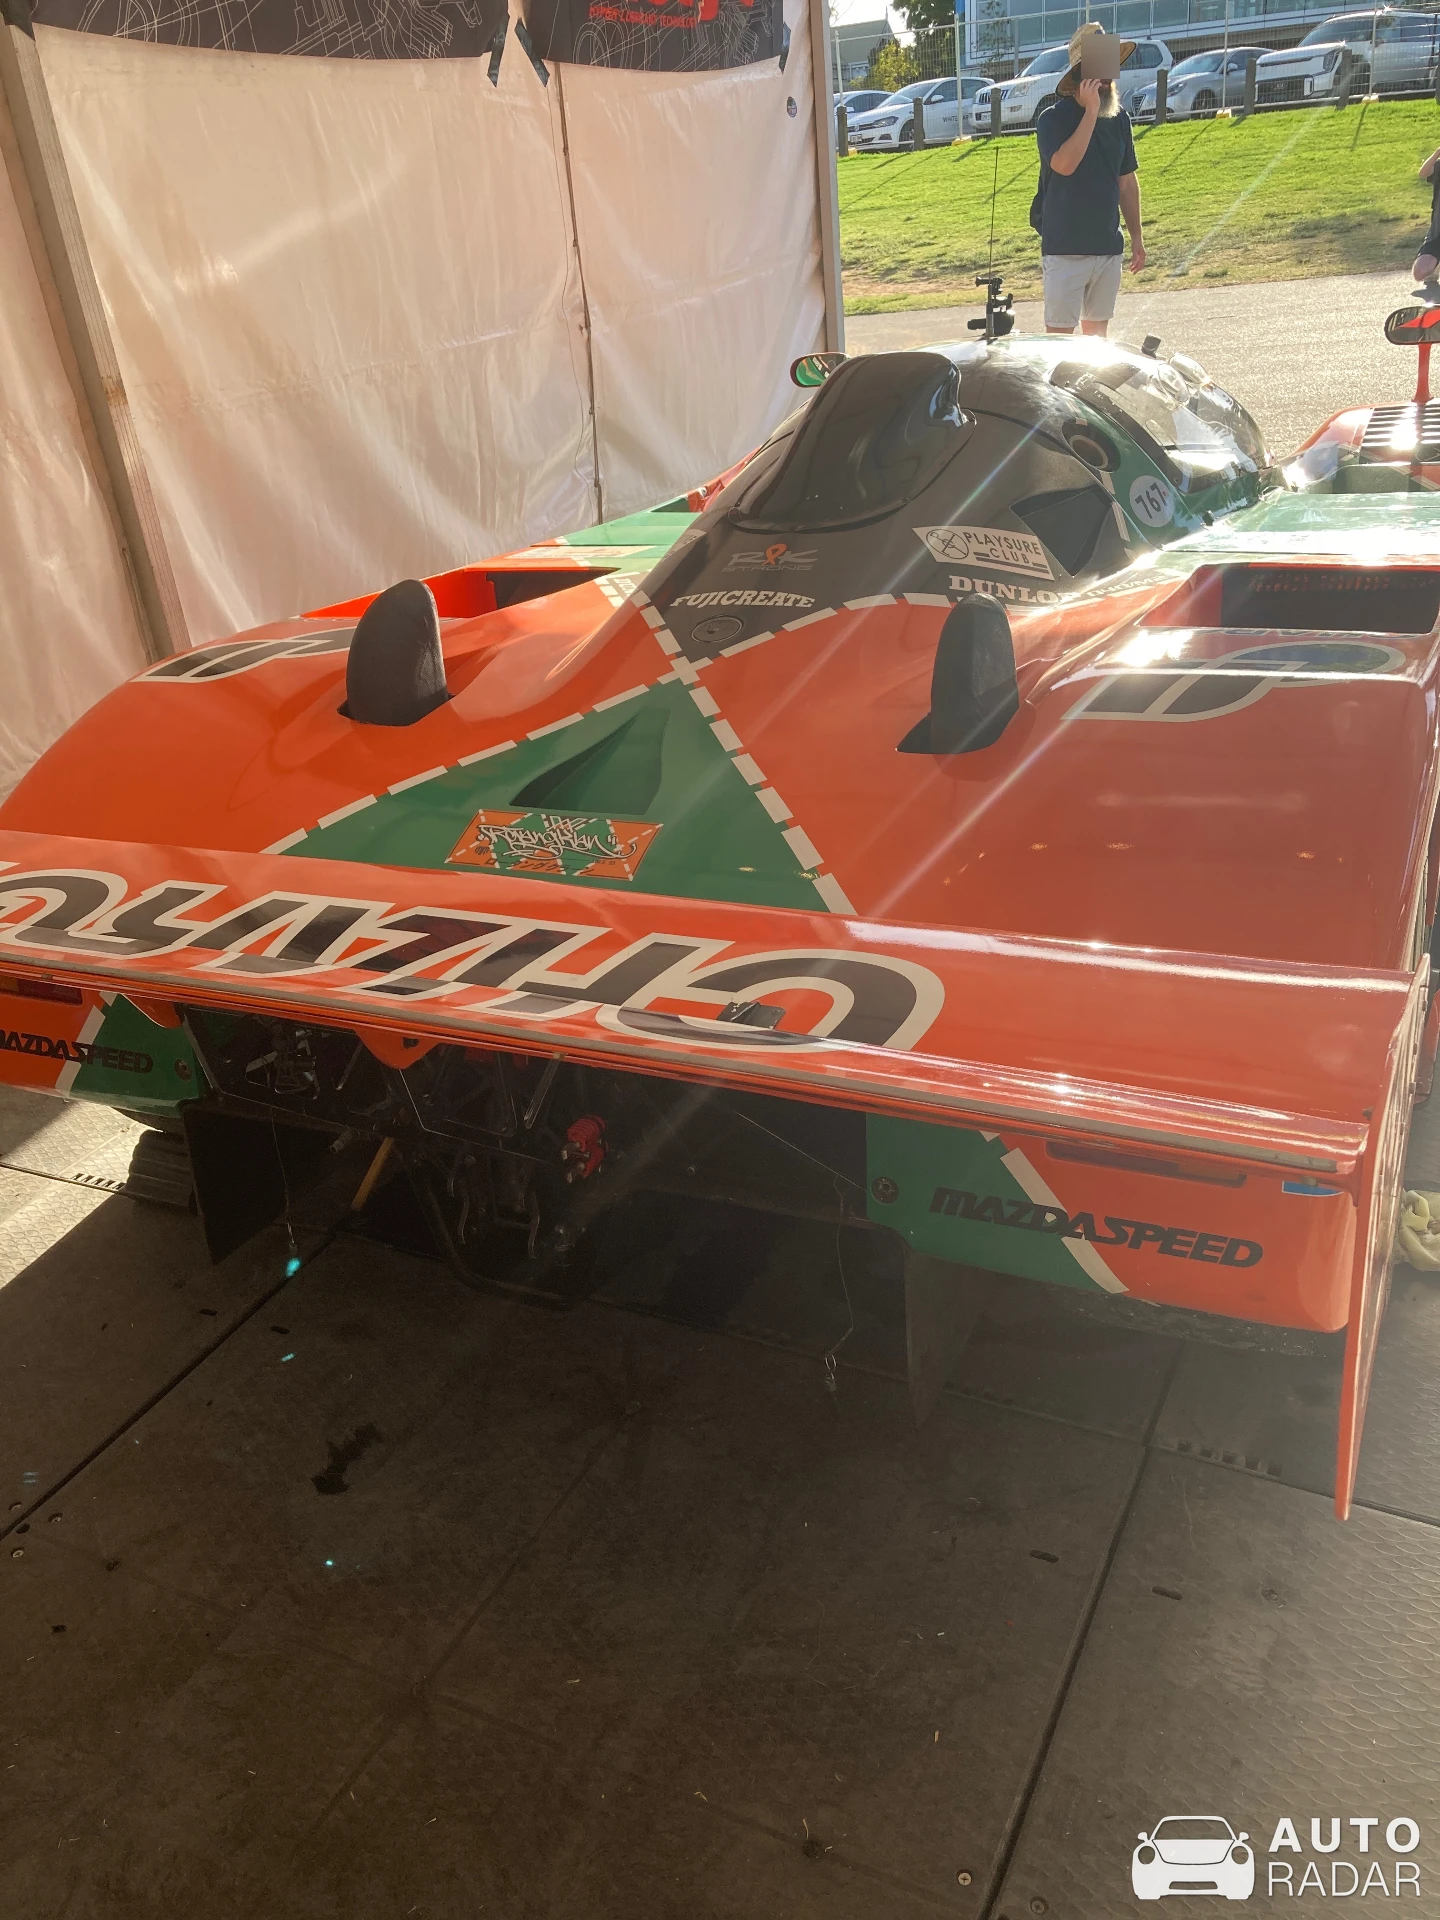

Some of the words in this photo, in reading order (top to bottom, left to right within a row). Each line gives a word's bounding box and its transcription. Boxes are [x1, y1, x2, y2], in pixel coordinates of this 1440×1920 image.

[1134, 482, 1167, 519] 767
[963, 531, 1042, 556] PLAYSURE
[989, 547, 1030, 564] CLUB
[721, 565, 813, 573] STRONG
[669, 590, 816, 609] FUJICREATE
[948, 575, 1081, 604] DUNLOP
[0, 862, 946, 1052] CHARG
[928, 1186, 1264, 1268] MAZDASPEED
